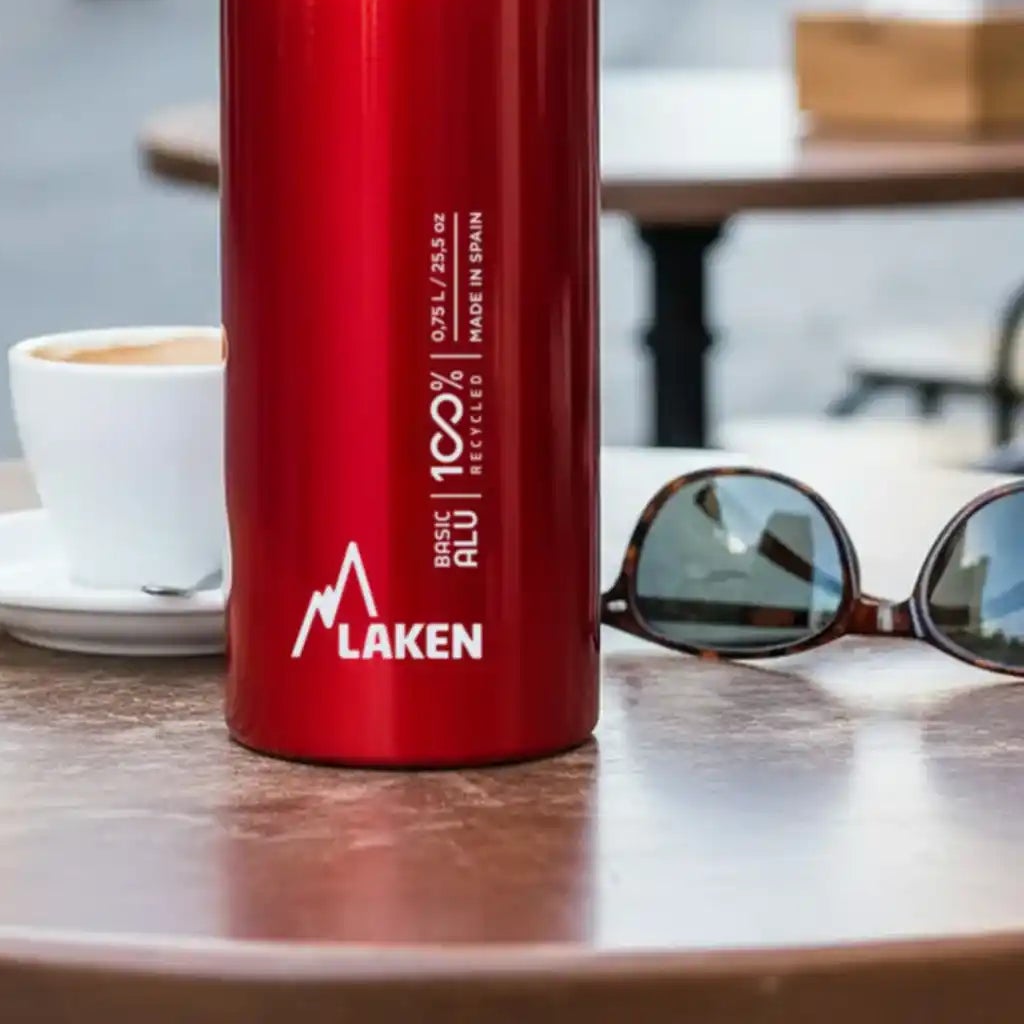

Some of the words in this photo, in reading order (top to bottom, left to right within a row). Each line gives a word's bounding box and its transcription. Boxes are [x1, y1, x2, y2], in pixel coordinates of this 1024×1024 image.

[434, 213, 445, 233] oz
[469, 212, 482, 263] SPAIN
[431, 237, 447, 273] 25,5
[431, 291, 445, 301] L
[469, 268, 482, 286] IN
[431, 306, 447, 342] 0,75
[469, 292, 482, 343] MADE
[470, 375, 482, 475] RECYCLED
[434, 511, 451, 568] BASIC
[453, 510, 478, 568] ALU
[337, 622, 483, 660] LAKEN
